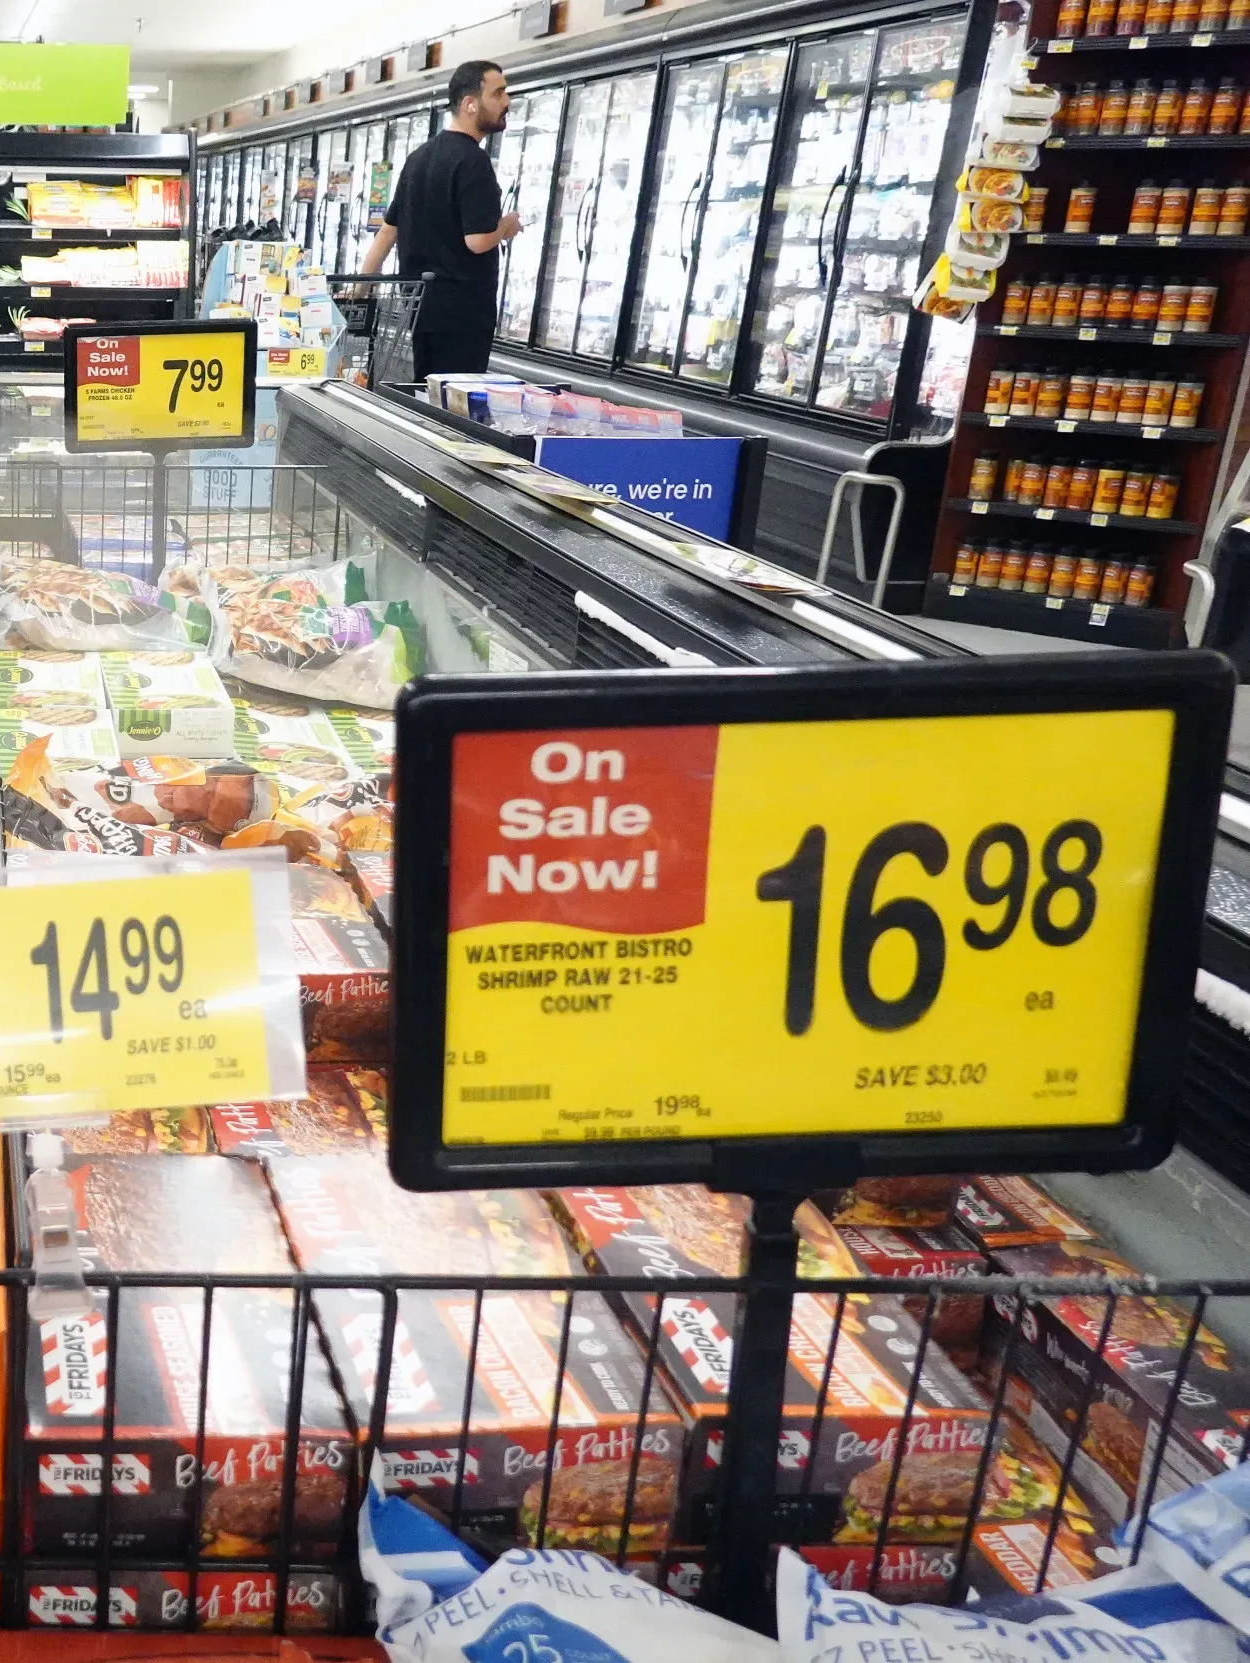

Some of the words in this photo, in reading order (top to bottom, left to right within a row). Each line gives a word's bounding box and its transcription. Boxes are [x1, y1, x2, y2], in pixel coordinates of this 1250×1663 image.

[96, 338, 118, 349] On
[89, 352, 126, 363] Sale
[87, 365, 129, 377] Now!
[629, 479, 687, 500] we're
[693, 479, 713, 499] in
[531, 741, 625, 783] On
[499, 796, 650, 839] Sale
[486, 851, 658, 894] Now!
[465, 941, 607, 964] WATERFRONT
[616, 938, 692, 959] BISTRO
[340, 977, 390, 1003] Pattie
[478, 969, 558, 990] SHRIMP
[564, 968, 610, 987] RAW
[619, 966, 678, 984] 21-25
[179, 999, 208, 1020] ea
[541, 994, 612, 1014] COUNT
[1025, 991, 1054, 1011] ea
[127, 1037, 170, 1055] SAVE
[175, 1034, 216, 1052] $1.00
[446, 1052, 457, 1065] 2
[463, 1051, 487, 1065] LB
[854, 1065, 918, 1089] SAVE
[925, 1063, 987, 1085] $3.00
[558, 1109, 600, 1122] Regular
[604, 1107, 633, 1119] Price
[672, 1310, 729, 1373] FRIDAYS
[66, 1322, 90, 1391] FRIDAYS
[509, 1569, 606, 1600] SHELL
[423, 1586, 494, 1636] PEEL
[856, 1637, 943, 1663] PEEL
